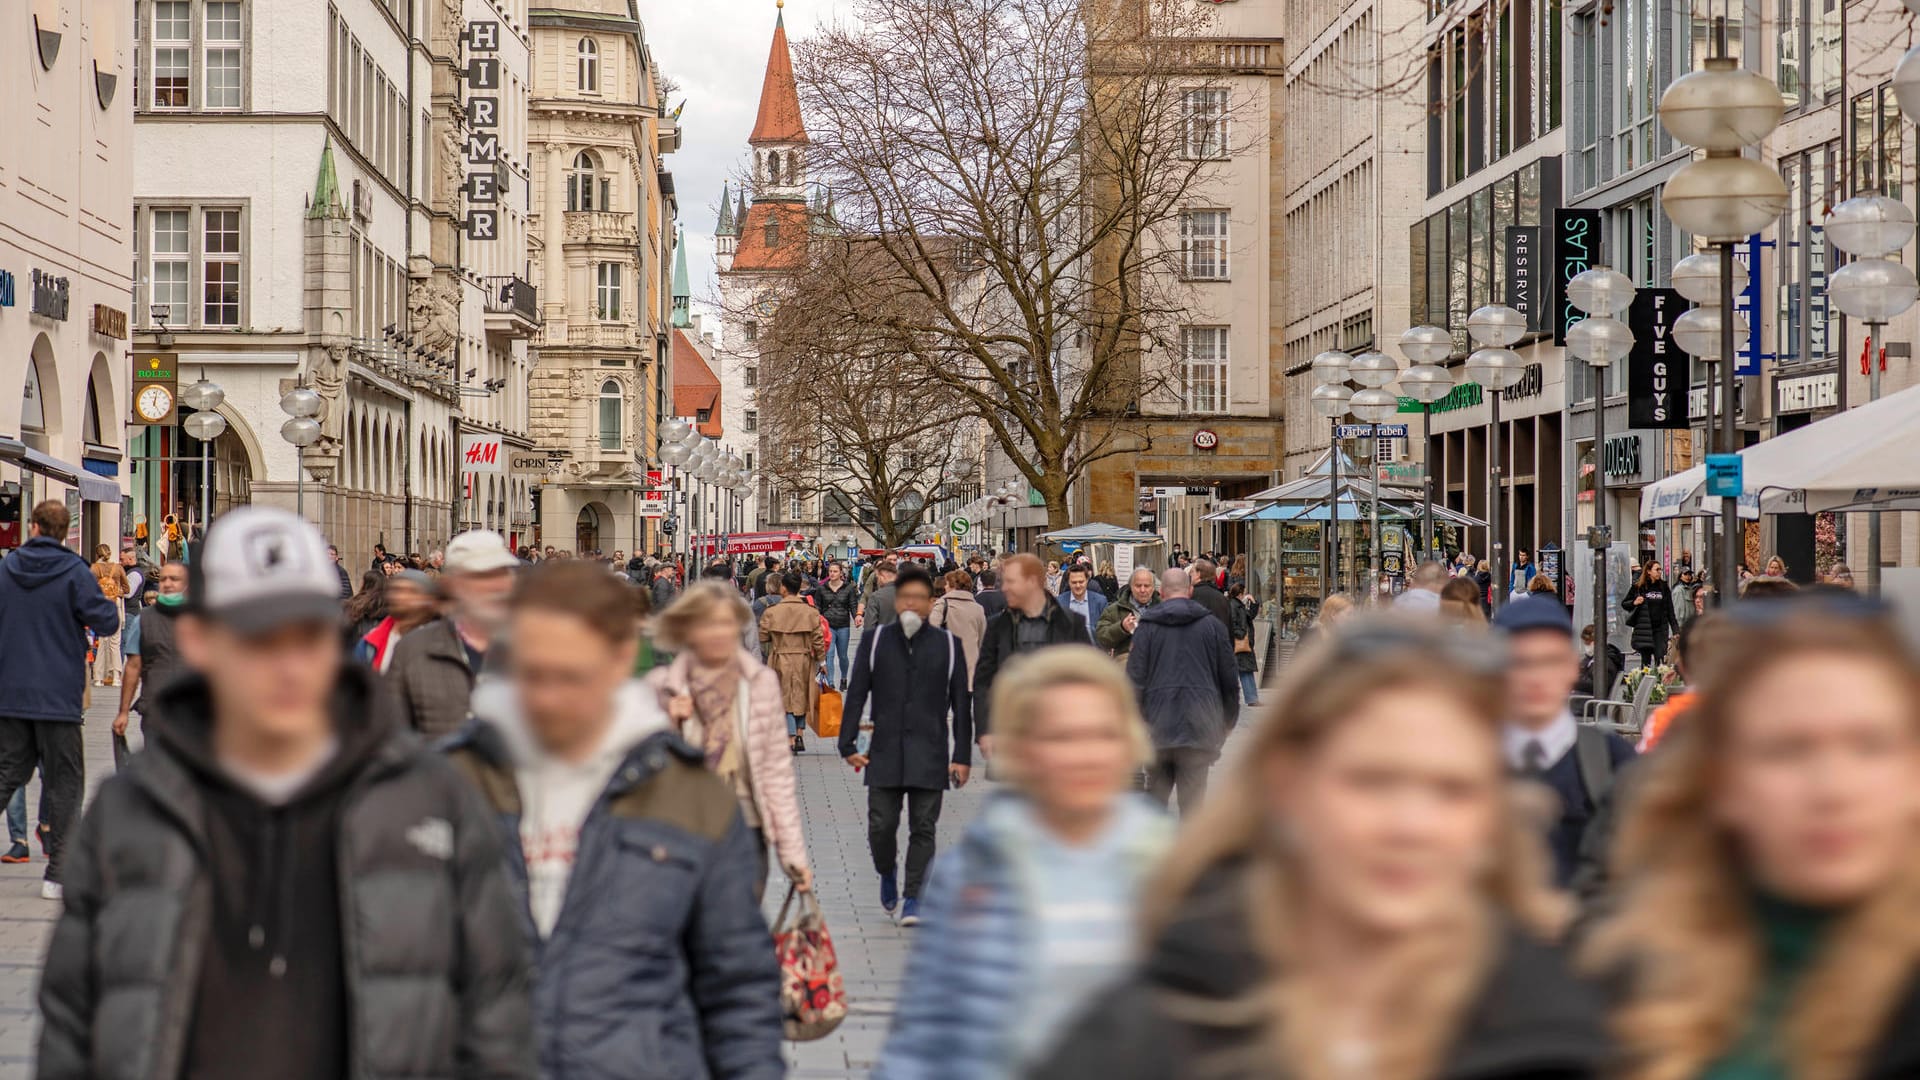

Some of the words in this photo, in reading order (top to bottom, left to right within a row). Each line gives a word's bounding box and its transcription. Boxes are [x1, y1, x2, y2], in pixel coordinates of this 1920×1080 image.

[470, 25, 497, 237] HIRMER
[1654, 296, 1666, 354] FIVE
[137, 370, 171, 378] ROLEX
[1653, 362, 1667, 421] GUYS
[1778, 373, 1838, 412] TRETTER
[1197, 435, 1214, 444] C&A
[1341, 425, 1404, 437] Färberraben
[465, 442, 498, 464] H&M
[953, 518, 968, 535] S
[742, 541, 773, 551] Maroni
